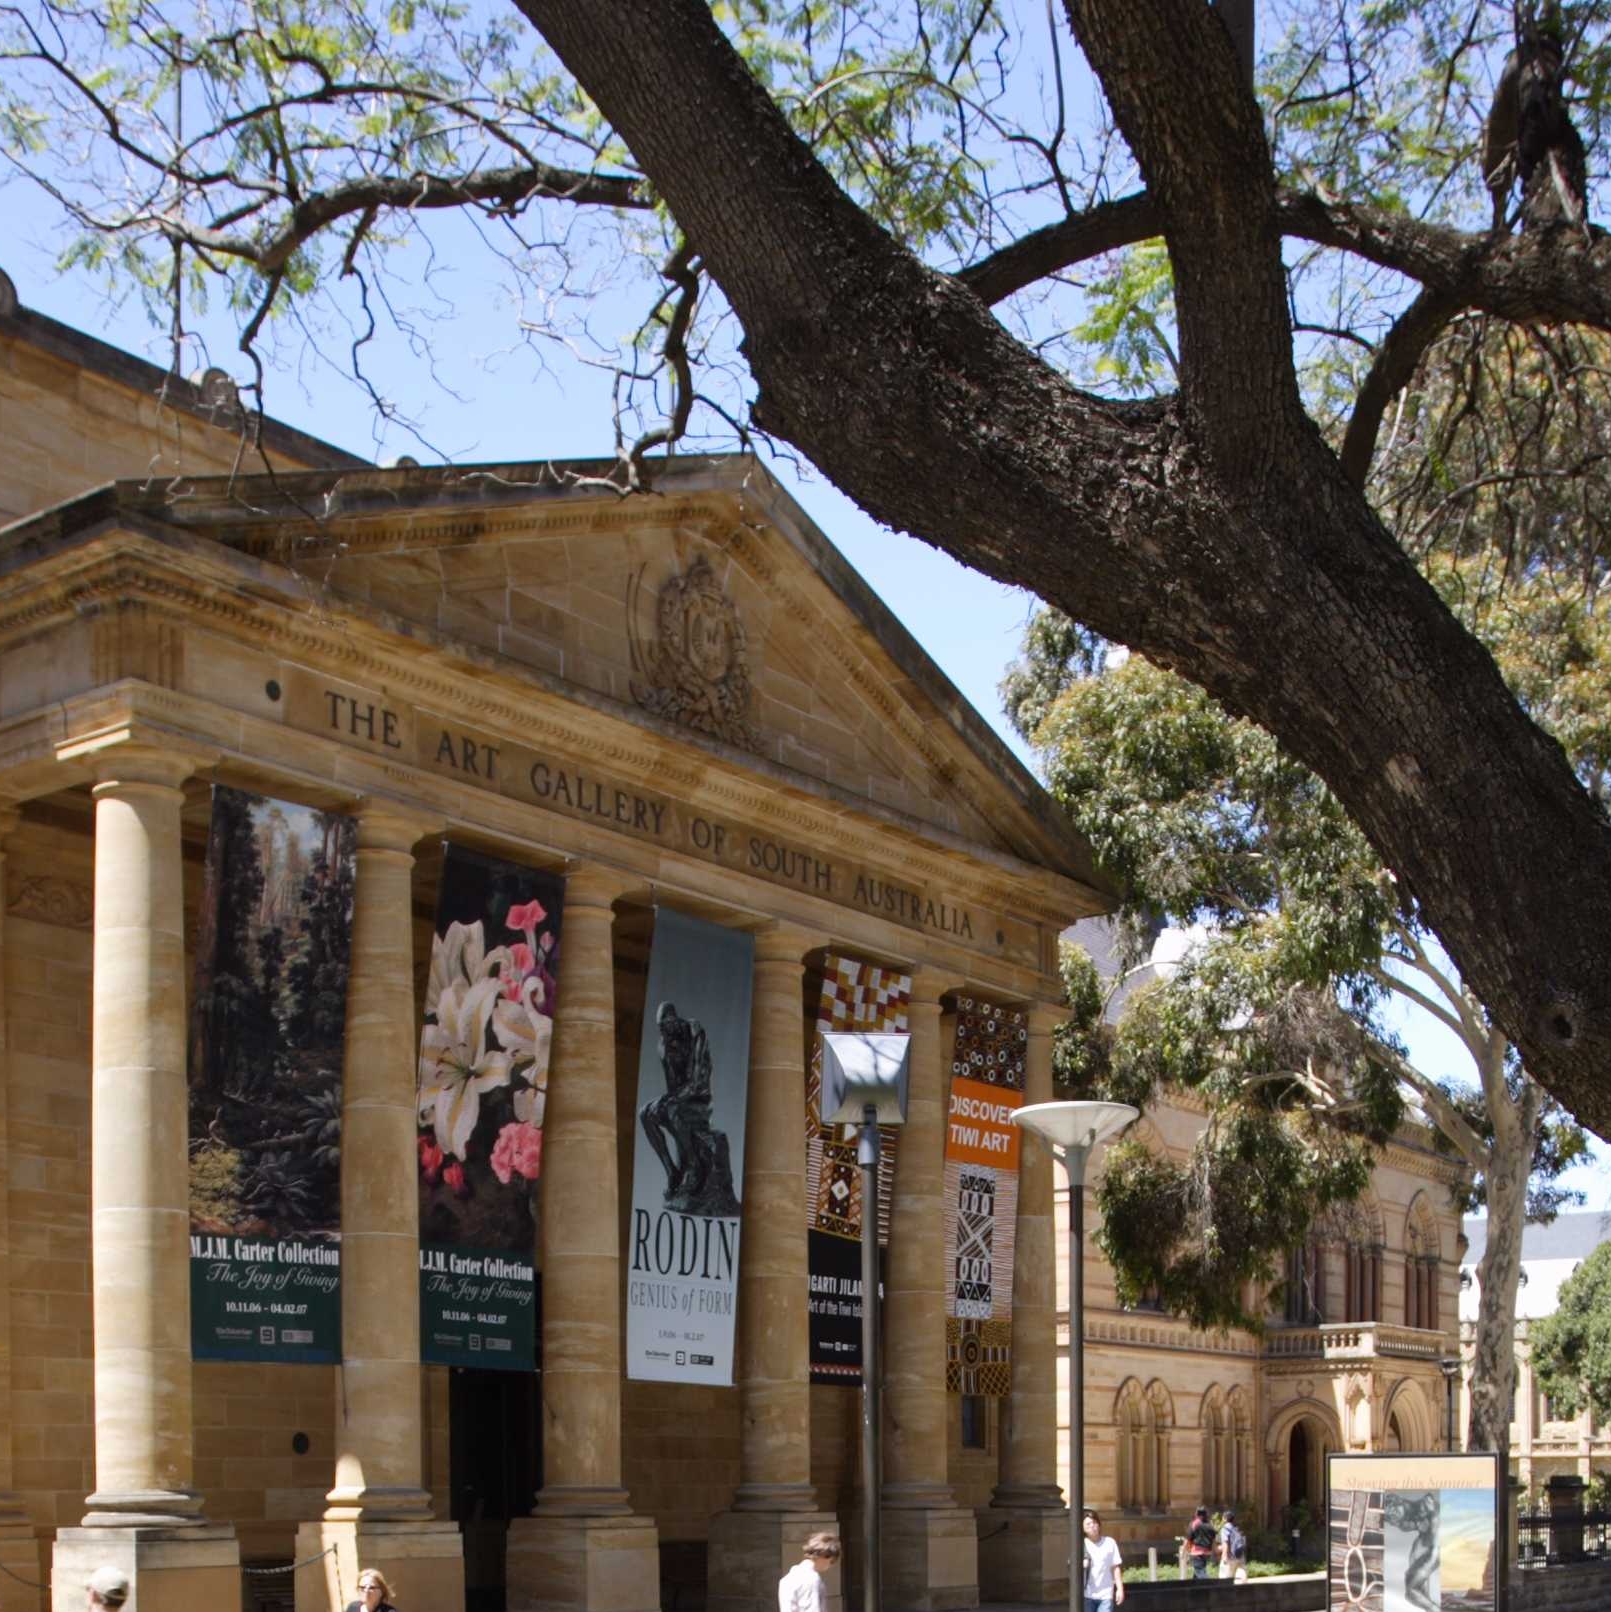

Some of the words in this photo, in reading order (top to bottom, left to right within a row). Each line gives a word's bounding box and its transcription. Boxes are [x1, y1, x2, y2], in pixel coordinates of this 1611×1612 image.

[324, 690, 401, 749] THE
[435, 730, 501, 780] ART
[530, 762, 667, 835] GALLERY
[692, 818, 725, 851] OF
[749, 835, 833, 893] SOUTH
[853, 875, 975, 940] AUSTRALIA
[950, 1124, 979, 1148] TIWI
[980, 1131, 1010, 1153] ART
[234, 1238, 275, 1263] Carter
[277, 1241, 340, 1267] Collection
[632, 1208, 738, 1283] RODIN
[206, 1263, 239, 1283] The
[238, 1265, 272, 1291] Joy
[273, 1266, 295, 1291] of
[293, 1267, 339, 1294] Giving
[450, 1253, 482, 1276] Carter
[483, 1257, 533, 1281] Collection
[427, 1275, 453, 1292] The
[452, 1278, 479, 1300] Joy
[479, 1280, 499, 1303] of
[496, 1282, 533, 1306] Giving
[630, 1281, 677, 1310] GENIUS
[682, 1288, 695, 1315] of
[699, 1289, 733, 1316] FORM
[225, 1301, 262, 1313] 10.11.06
[270, 1303, 308, 1315] 04.02.07
